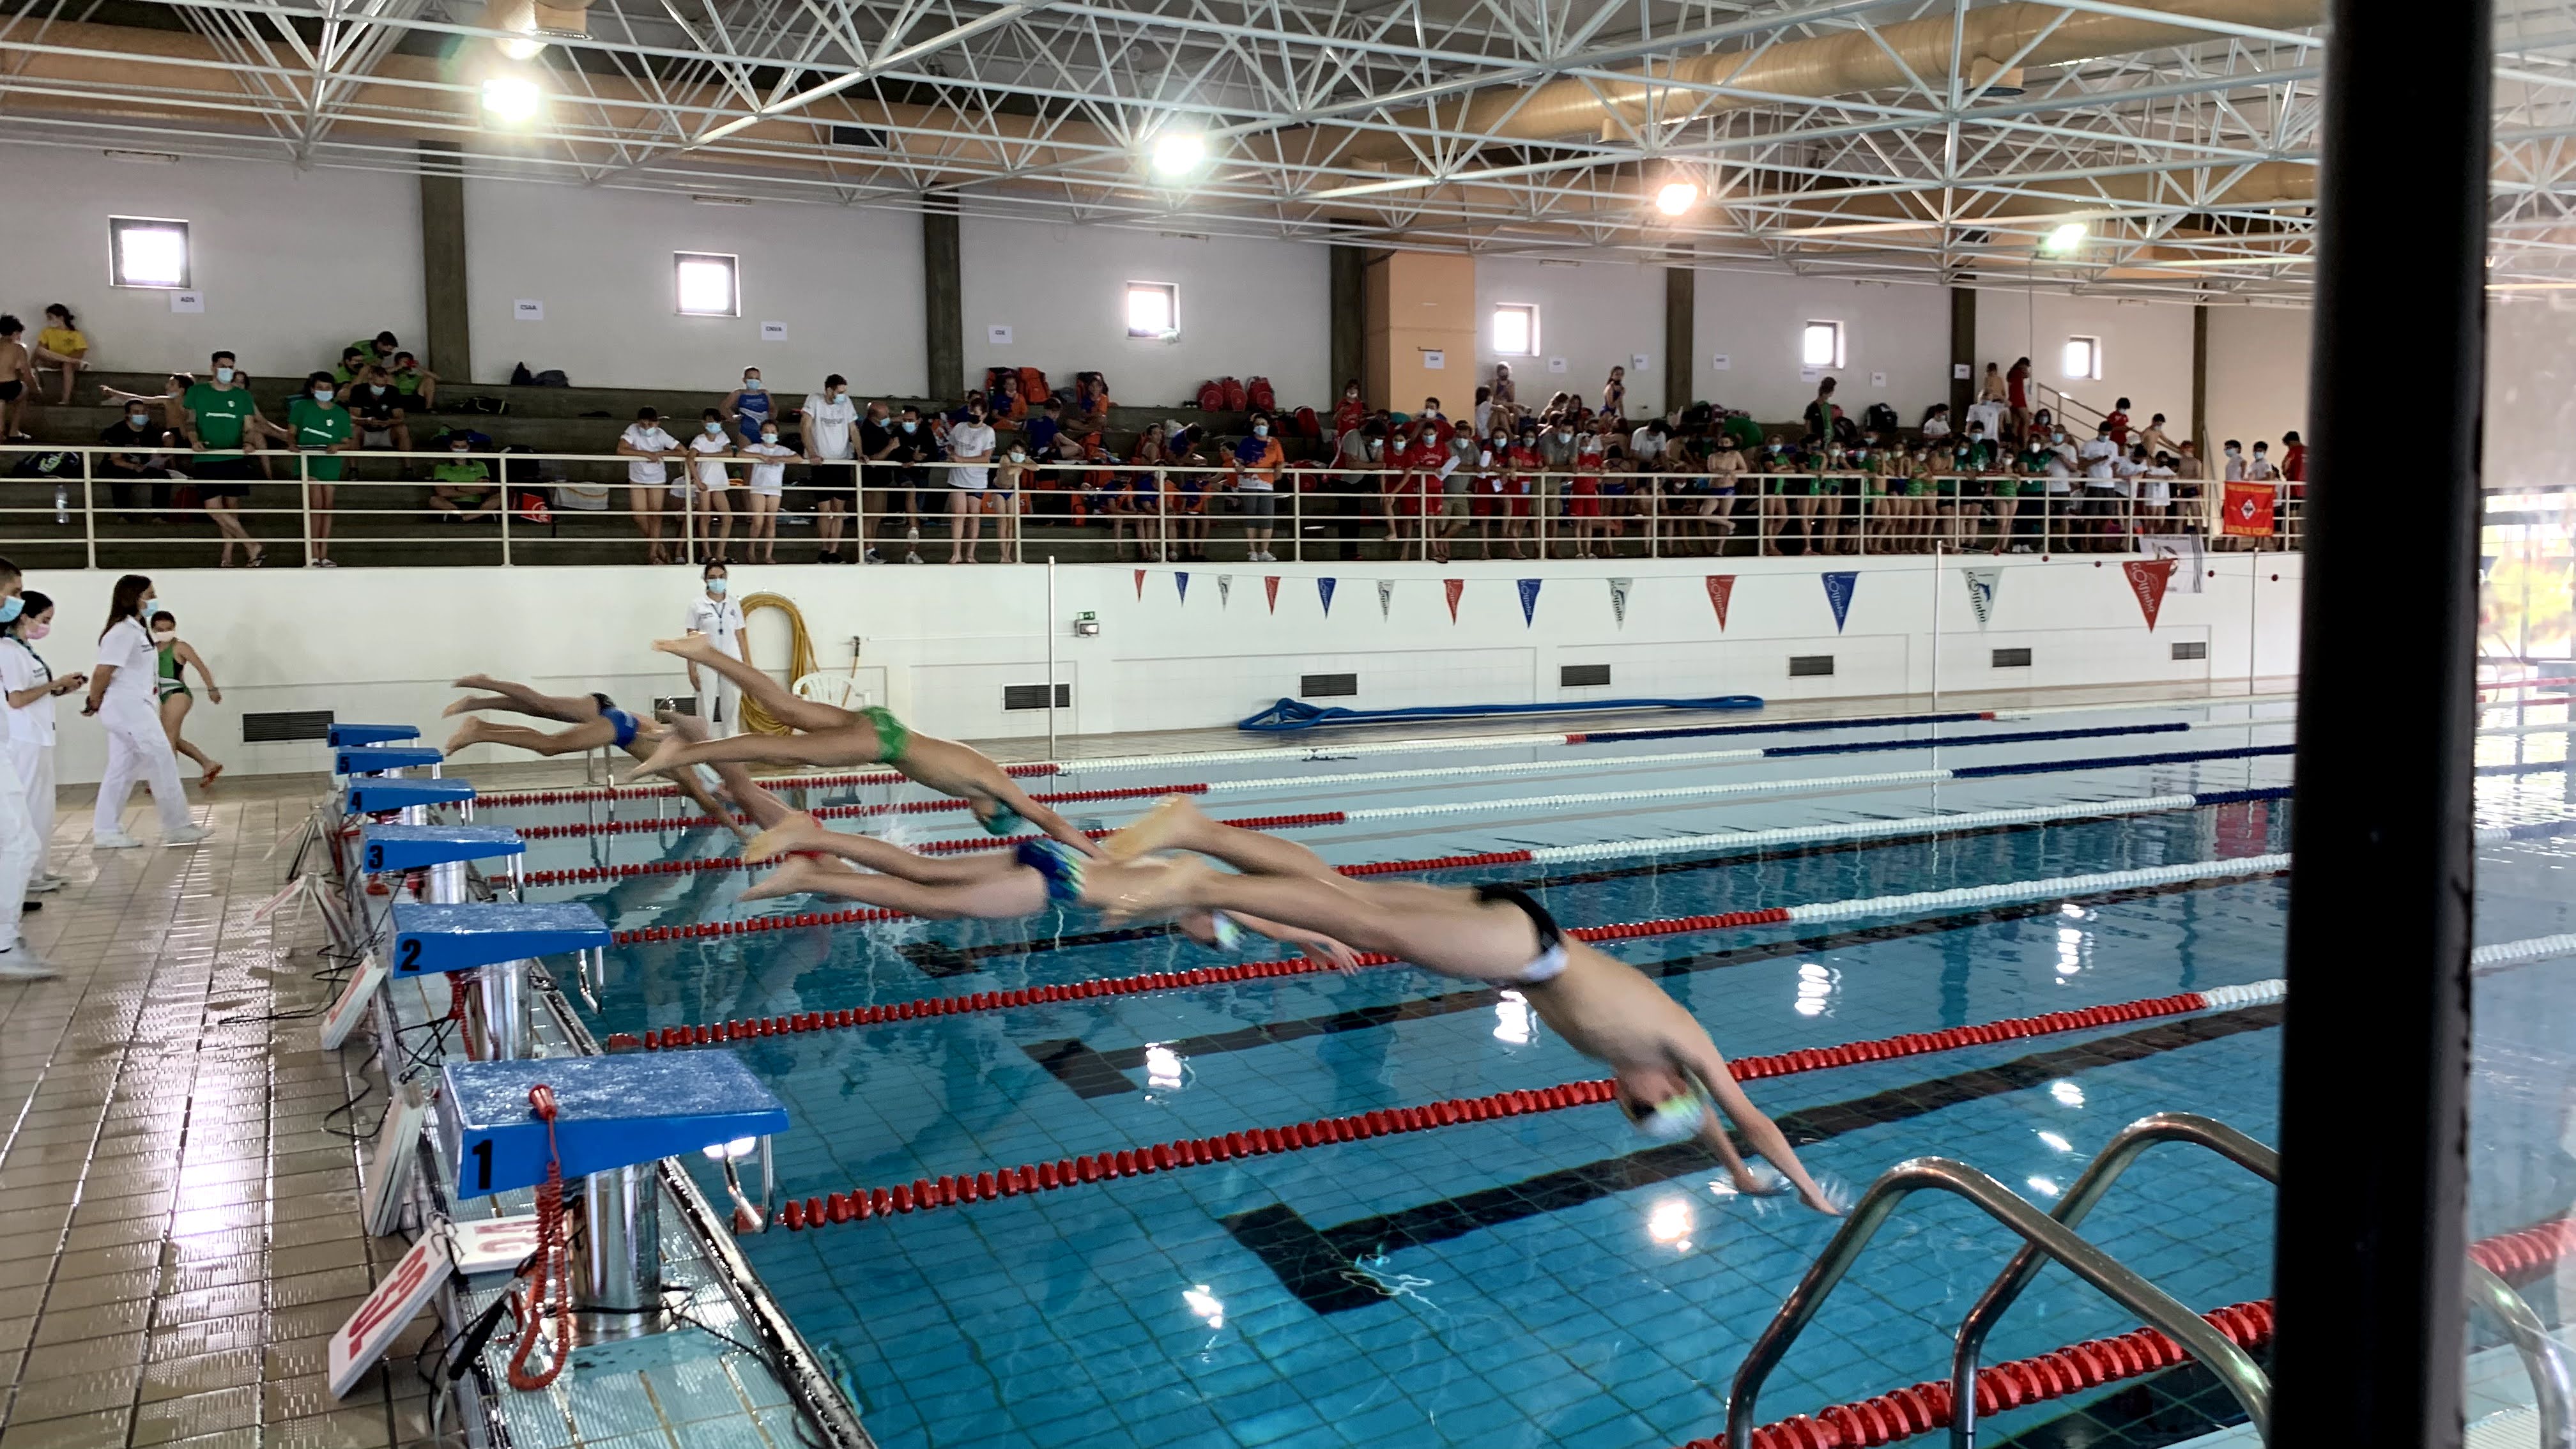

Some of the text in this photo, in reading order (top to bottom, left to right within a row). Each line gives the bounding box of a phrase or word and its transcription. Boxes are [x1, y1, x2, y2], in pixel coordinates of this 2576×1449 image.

[330, 732, 339, 746] 6
[339, 756, 350, 772] 5
[351, 791, 362, 811] 4
[369, 845, 383, 870] 3
[400, 939, 422, 972] 2
[470, 1139, 494, 1190] 1
